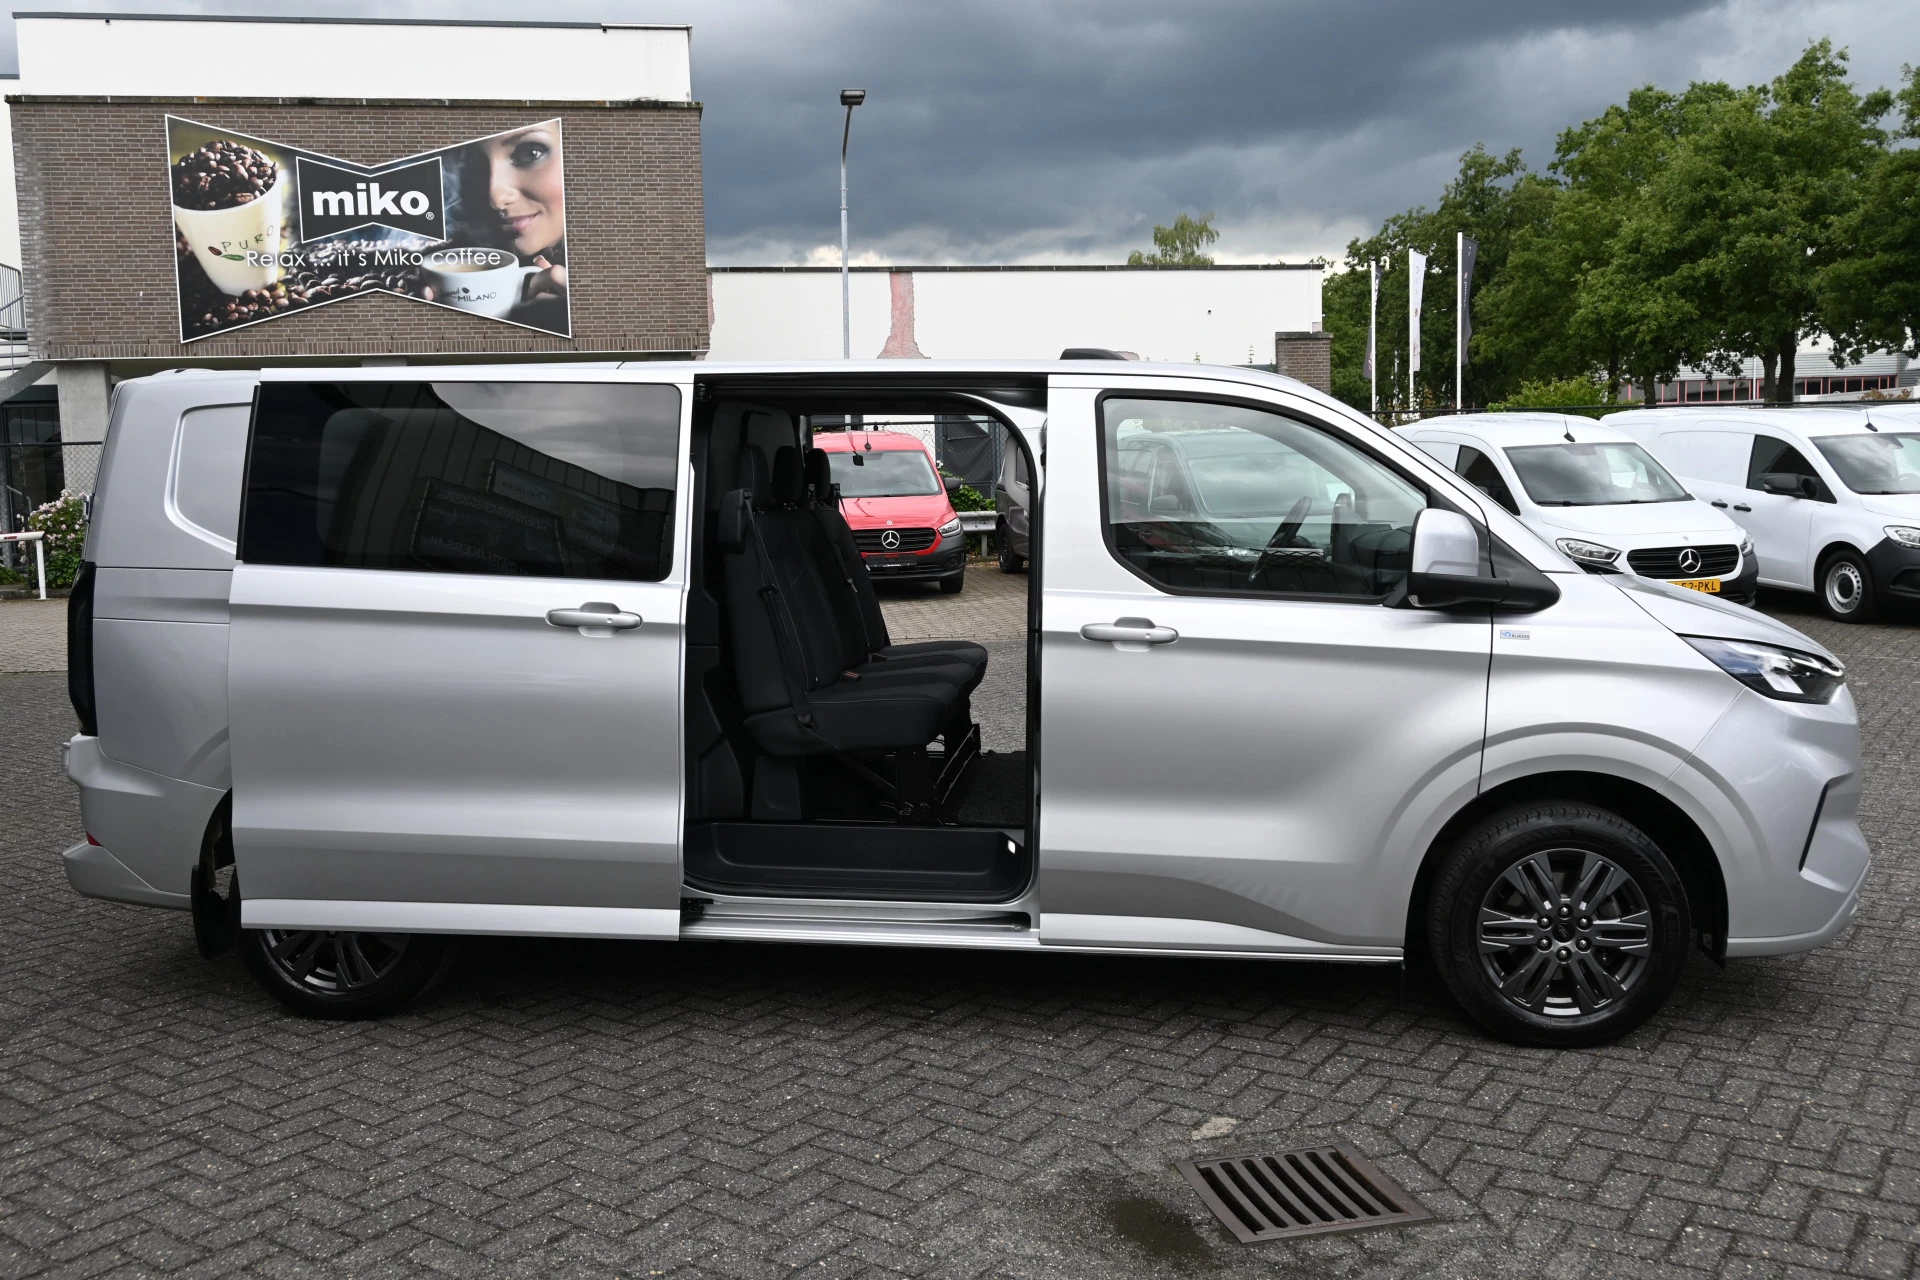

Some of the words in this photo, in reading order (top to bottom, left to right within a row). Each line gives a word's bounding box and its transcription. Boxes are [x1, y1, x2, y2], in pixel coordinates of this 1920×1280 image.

[221, 225, 274, 252] PURO
[246, 250, 306, 267] Relax
[338, 249, 367, 267] it's
[374, 248, 424, 266] Miko
[431, 248, 501, 265] coffee
[457, 292, 497, 302] MILANO
